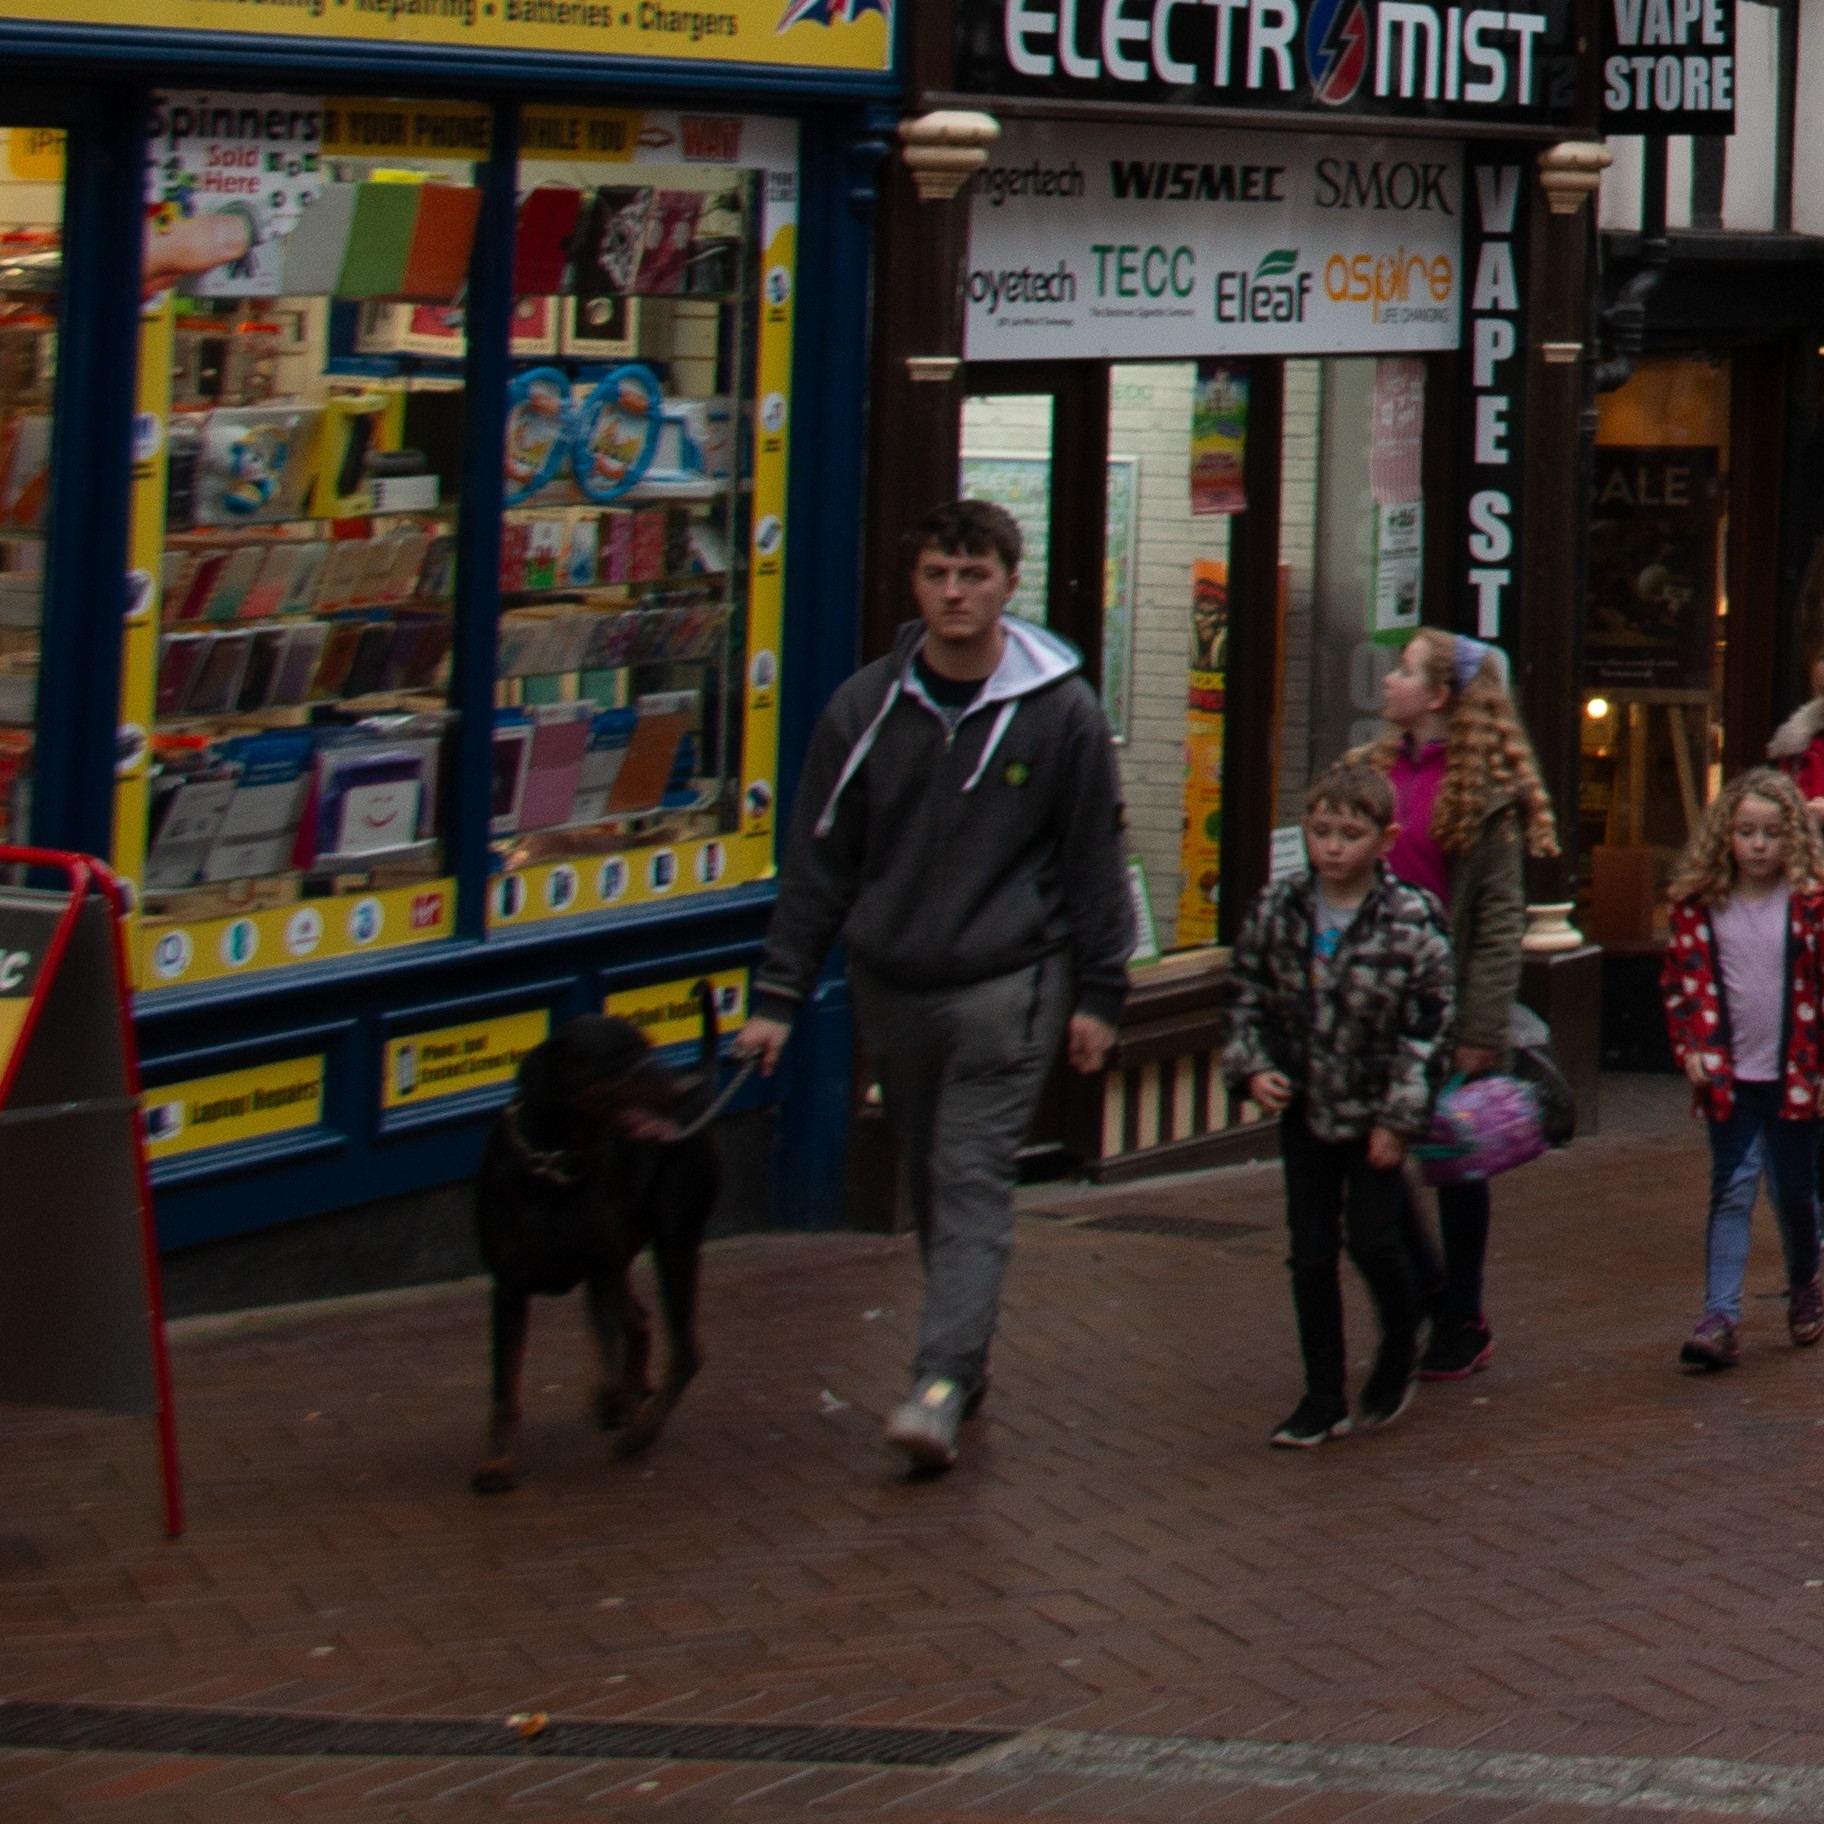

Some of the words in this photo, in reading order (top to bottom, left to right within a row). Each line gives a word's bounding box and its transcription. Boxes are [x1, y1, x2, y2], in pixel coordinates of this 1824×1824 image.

[637, 1, 738, 42] Chargers
[1604, 55, 1735, 113] STORE
[149, 94, 321, 152] Spinners
[208, 144, 260, 168] Sold
[205, 175, 261, 194] Here
[974, 160, 1085, 207] ngertech
[1315, 157, 1455, 217] SMOK
[963, 259, 1077, 315] oyetech
[1090, 244, 1196, 298] TECC
[1215, 269, 1313, 324] Eleaf
[1324, 246, 1453, 324] aspire
[1589, 465, 1692, 508] ALE
